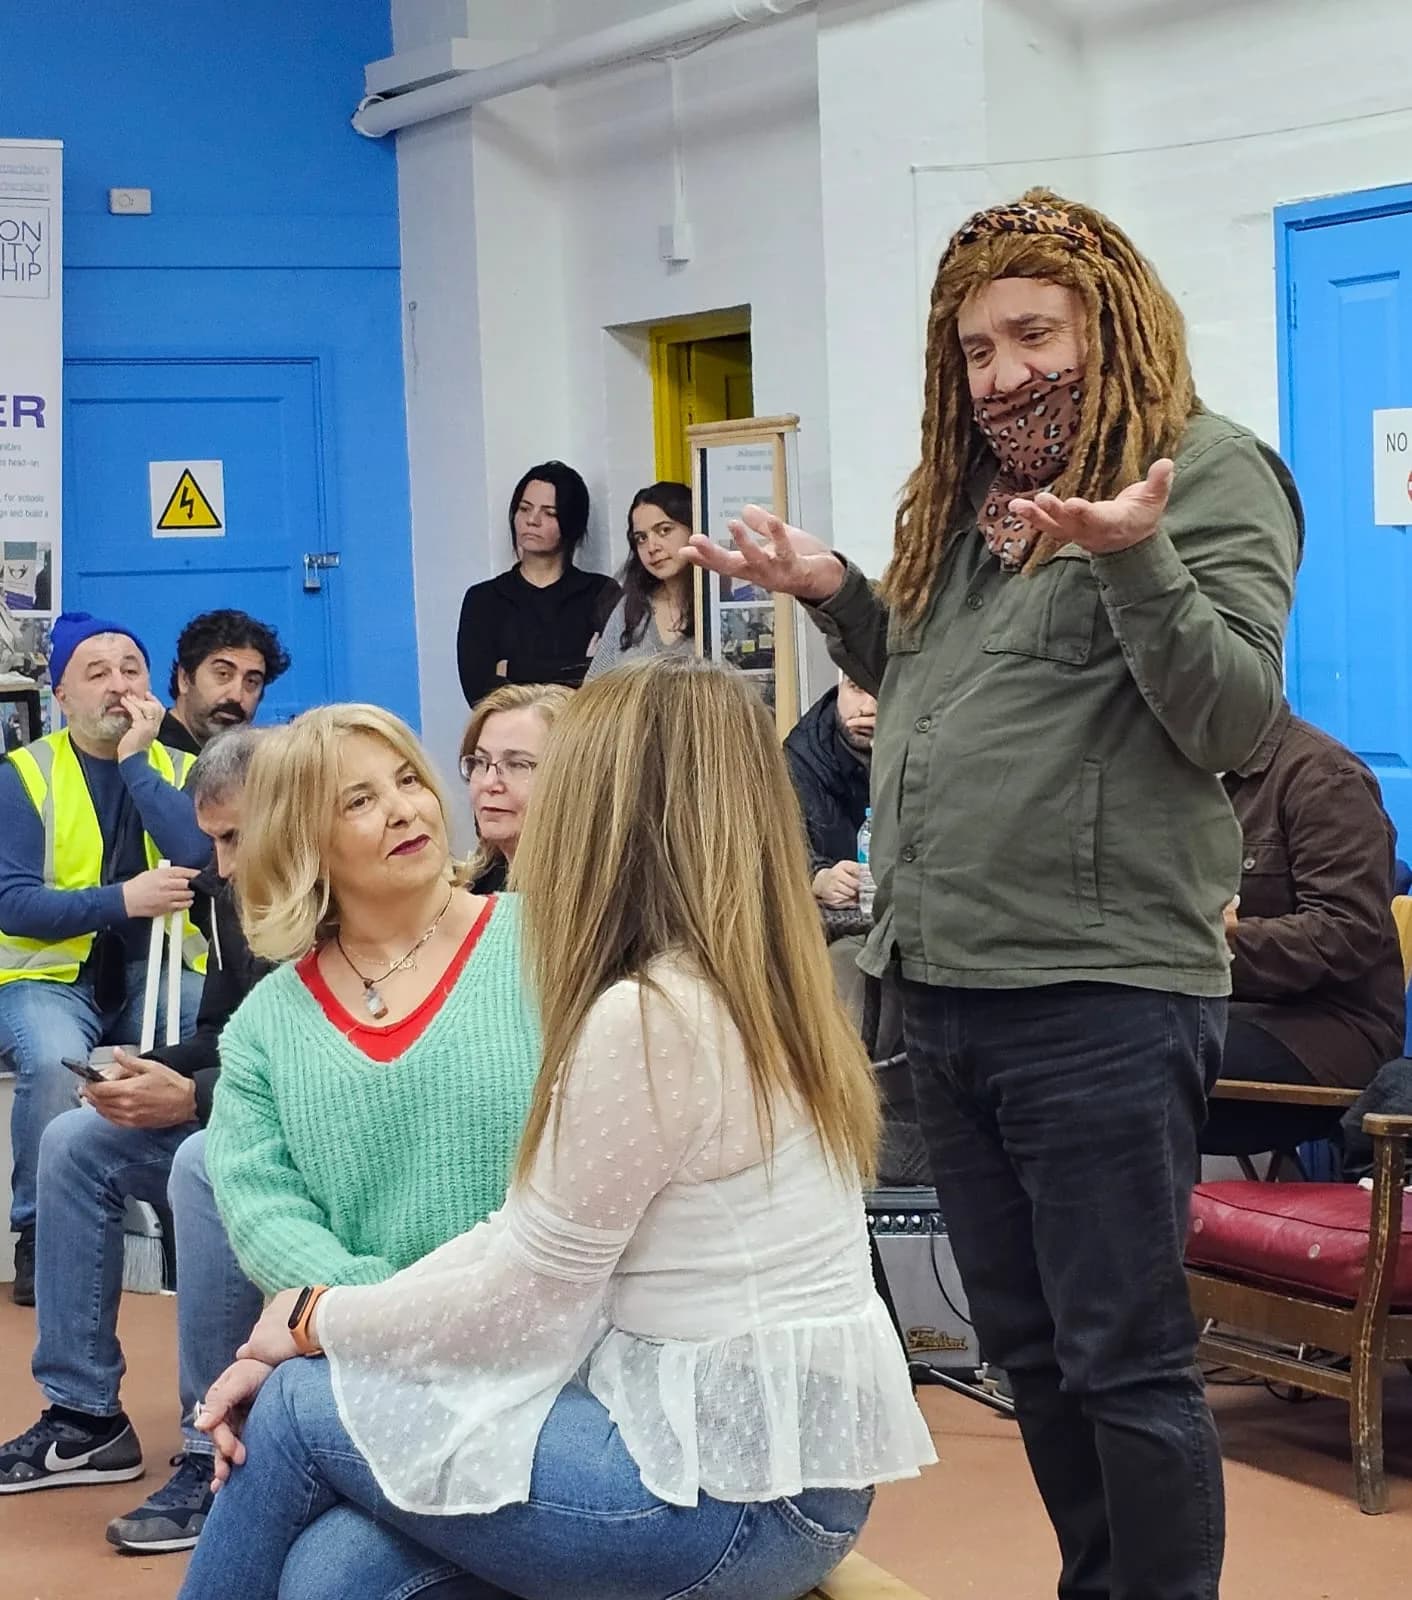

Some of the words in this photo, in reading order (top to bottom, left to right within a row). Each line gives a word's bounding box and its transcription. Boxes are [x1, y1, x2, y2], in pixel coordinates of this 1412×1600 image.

[0, 219, 42, 242] ON
[1, 242, 41, 263] ITY
[1, 262, 42, 281] HIP
[0, 394, 46, 428] R
[1386, 431, 1408, 453] NO
